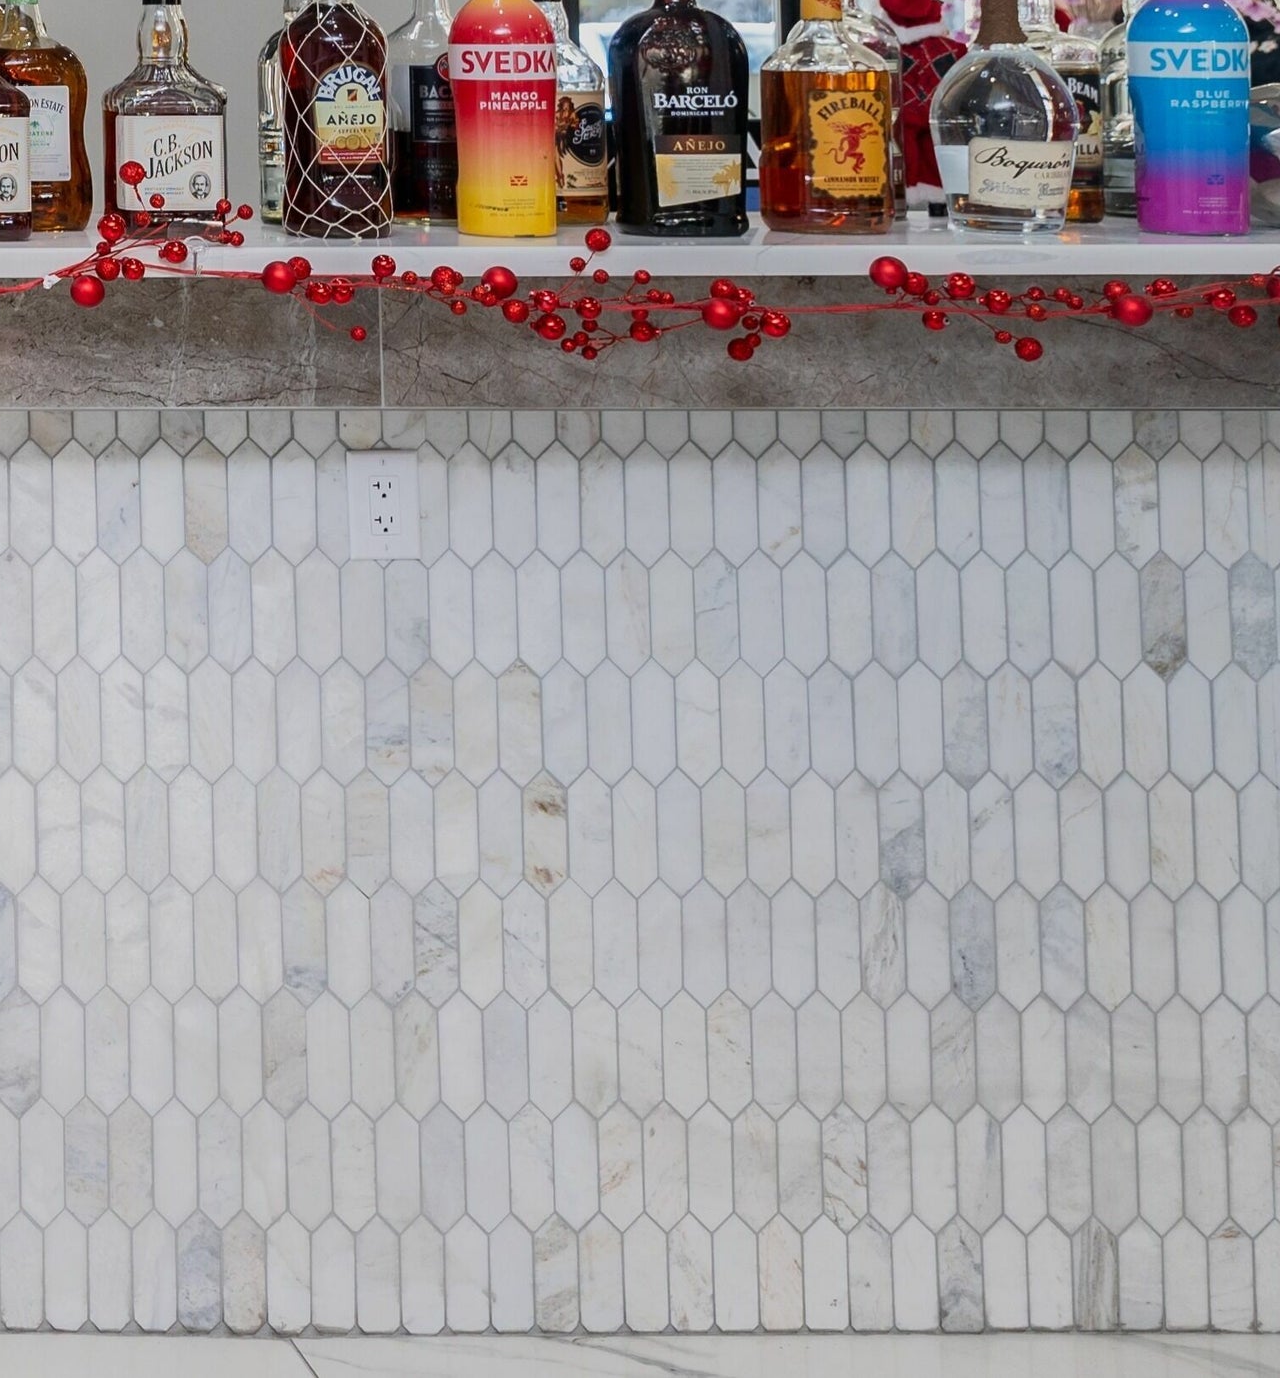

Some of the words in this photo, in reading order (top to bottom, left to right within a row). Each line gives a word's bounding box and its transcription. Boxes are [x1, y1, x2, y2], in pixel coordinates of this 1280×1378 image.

[461, 50, 556, 74] SVEDKA
[317, 66, 381, 101] BRUGAL
[686, 86, 708, 94] RON
[1067, 77, 1099, 104] BEAM
[491, 92, 538, 101] MANGO
[653, 90, 738, 110] BARCELÓ
[1195, 90, 1230, 99] BLUE
[41, 98, 65, 114] ESTATE
[480, 101, 547, 110] PINEAPPLE
[816, 97, 880, 122] FIREBALL
[326, 111, 376, 125] AÑEJO
[153, 133, 181, 157] C.B.
[673, 138, 726, 151] AÑEJO
[144, 140, 213, 179] JACKSON
